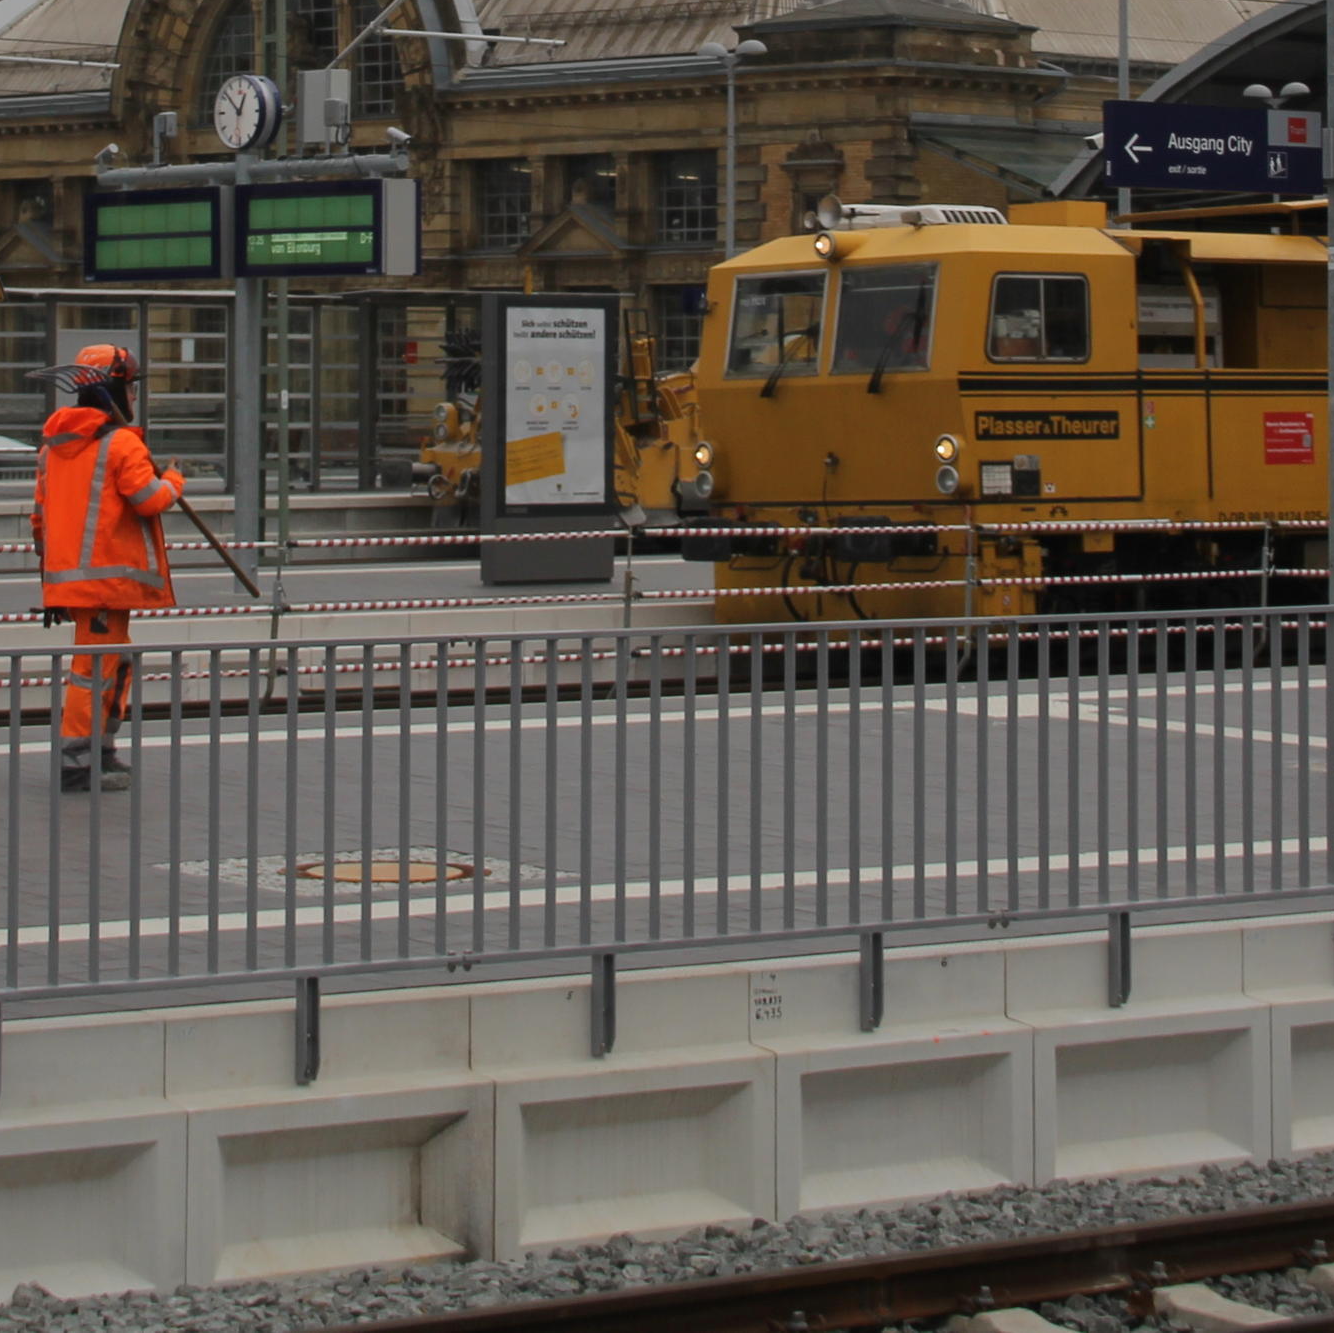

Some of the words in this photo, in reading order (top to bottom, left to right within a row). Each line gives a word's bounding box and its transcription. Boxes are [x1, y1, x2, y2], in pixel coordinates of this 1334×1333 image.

[1168, 133, 1225, 155] Ausgang
[1227, 135, 1253, 156] City
[553, 318, 588, 329] schützen
[530, 330, 557, 339] andere
[558, 329, 596, 340] schützen!
